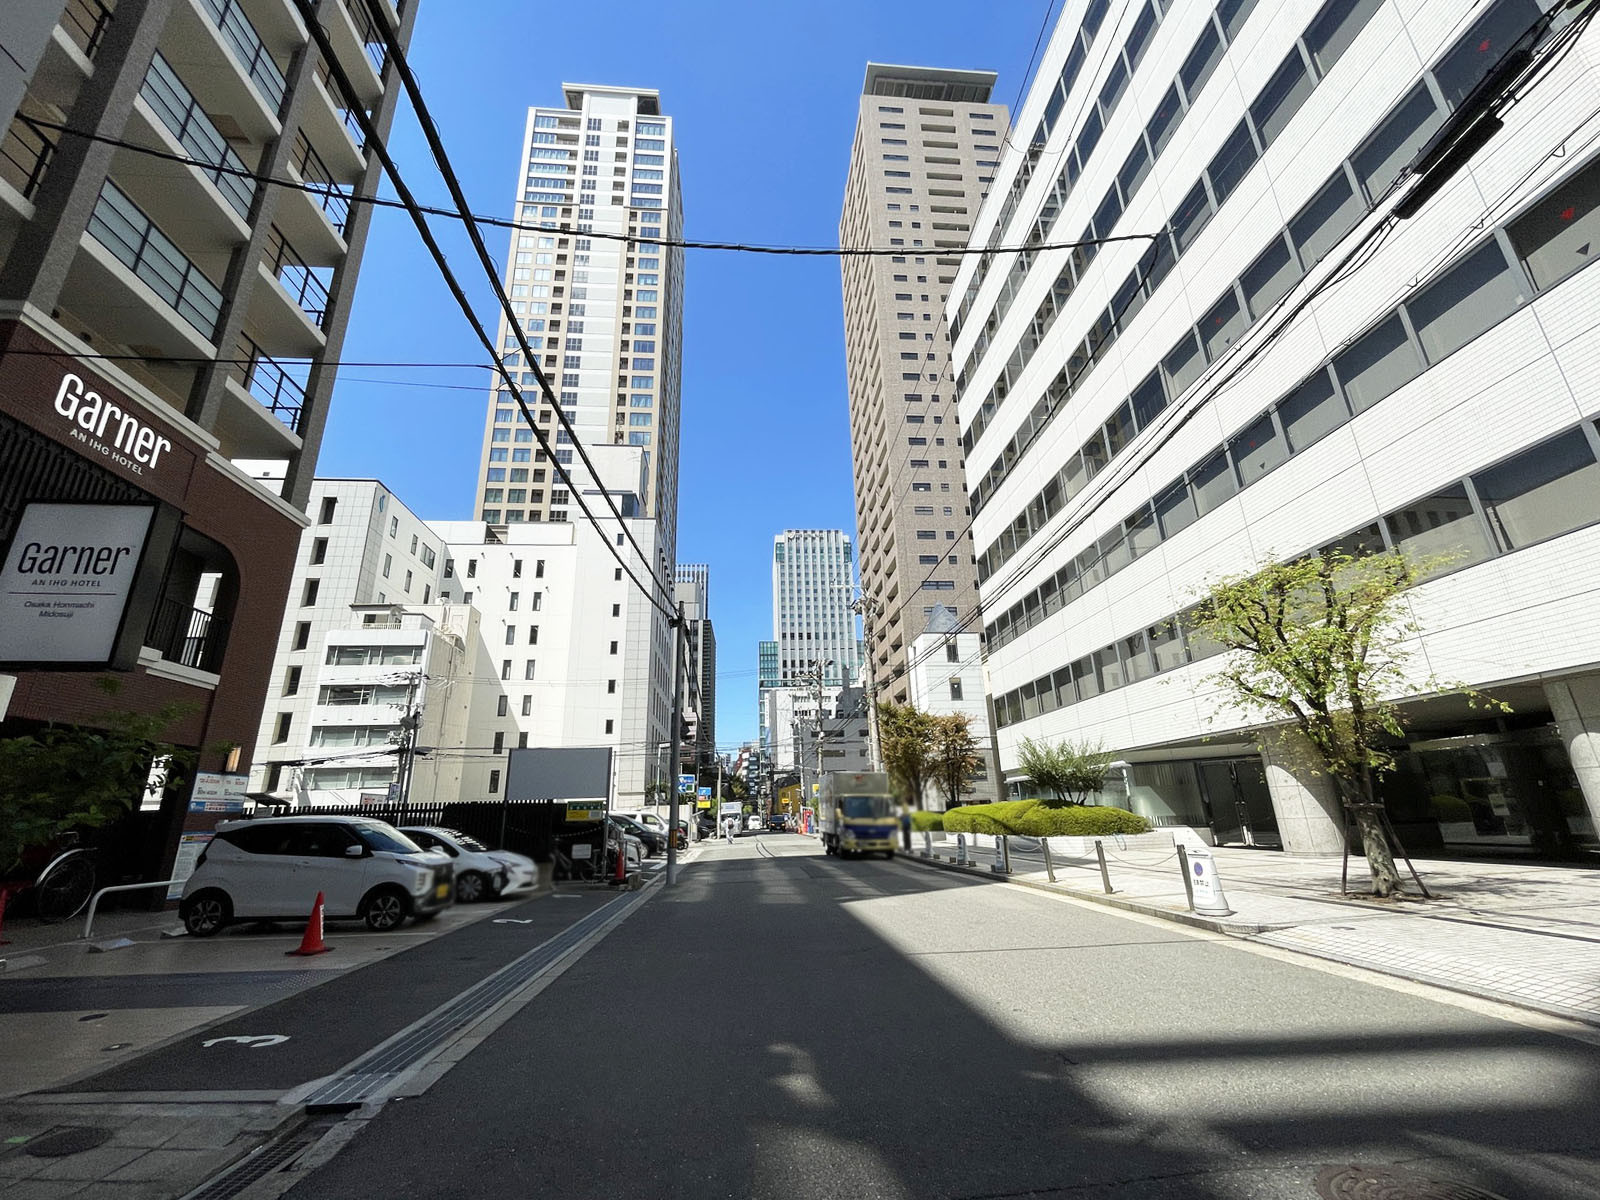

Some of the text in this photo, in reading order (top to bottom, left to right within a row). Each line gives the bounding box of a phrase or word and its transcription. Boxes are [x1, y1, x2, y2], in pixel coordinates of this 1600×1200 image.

[54, 373, 171, 470] Garner
[69, 428, 143, 476] AN IHG HOTEL
[17, 542, 131, 575] Garner
[49, 579, 68, 587] IHG
[70, 579, 102, 587] HOTEL
